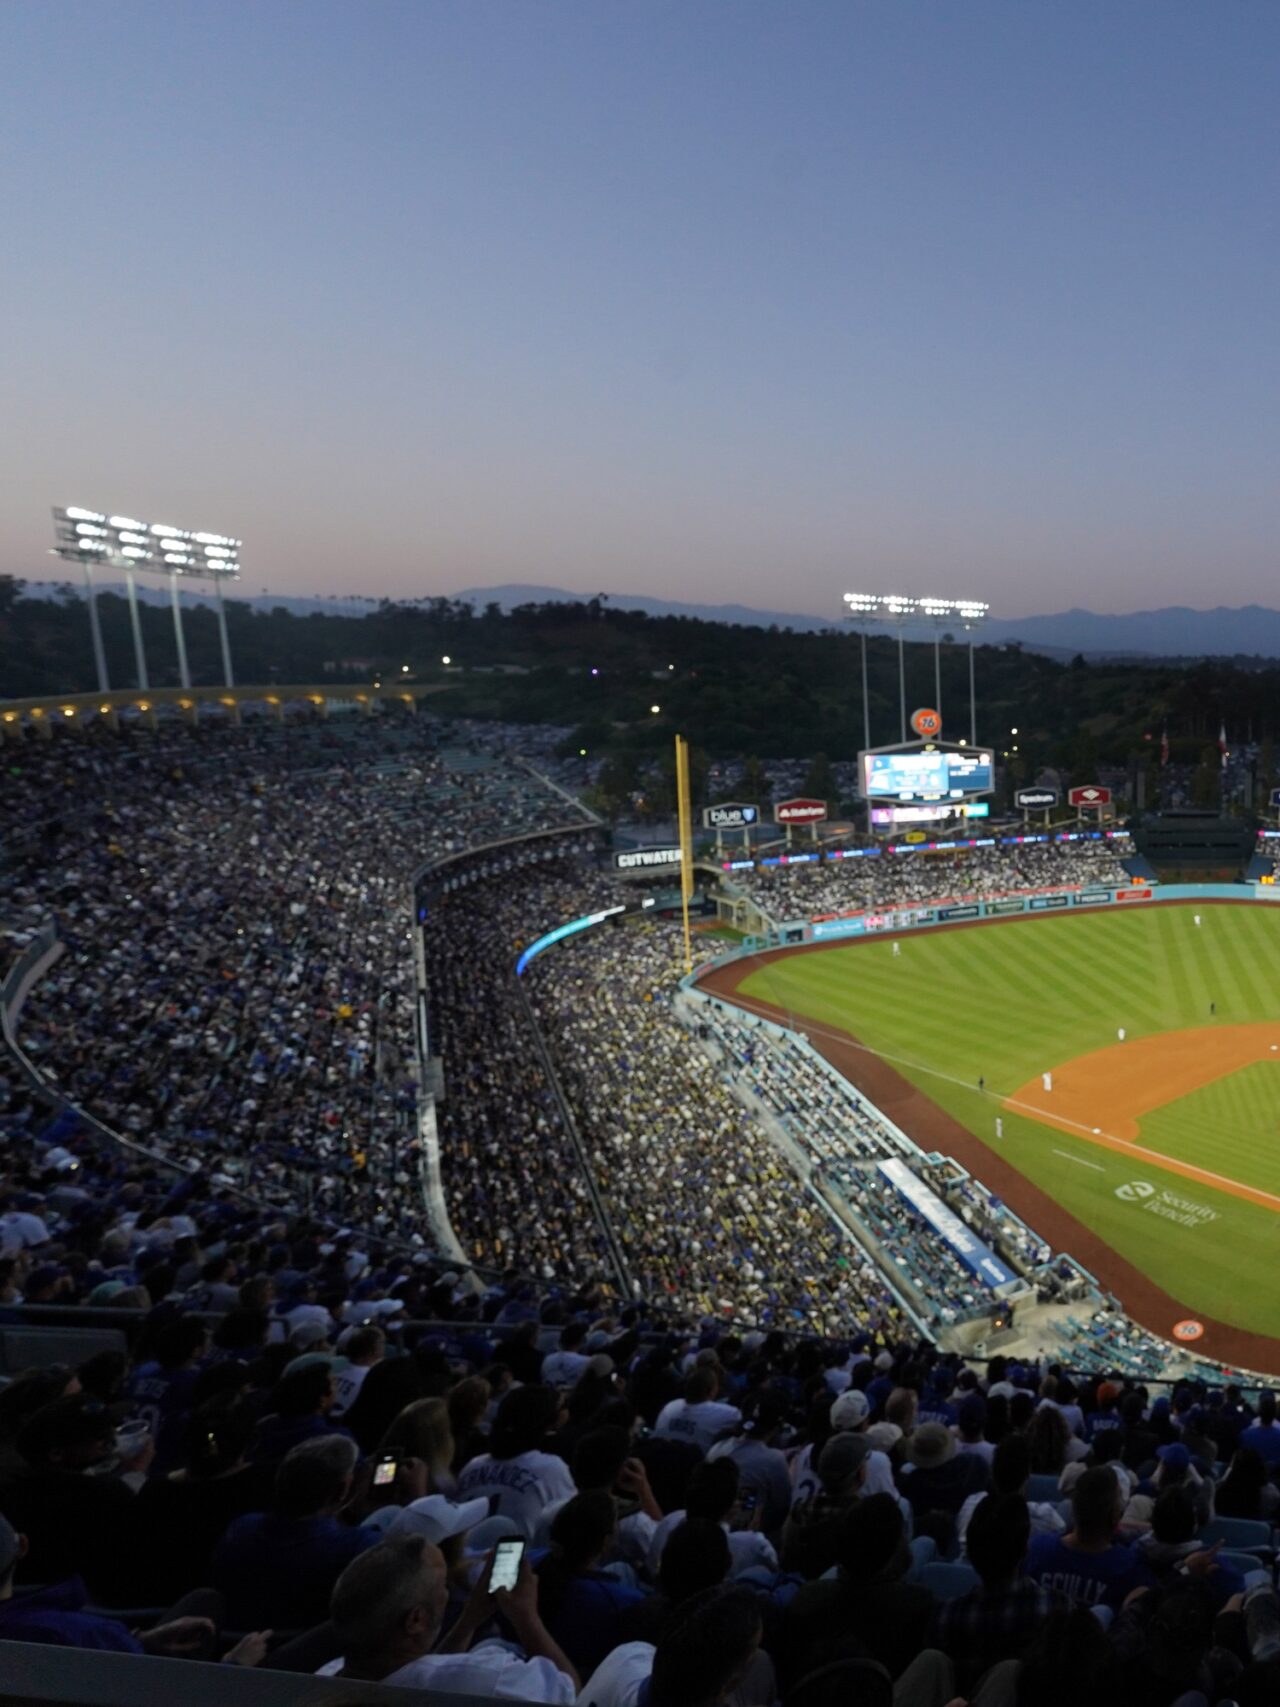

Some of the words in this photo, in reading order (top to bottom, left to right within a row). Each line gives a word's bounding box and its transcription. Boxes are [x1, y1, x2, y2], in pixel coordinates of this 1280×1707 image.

[922, 716, 935, 728] 76
[710, 809, 742, 822] blue
[1143, 1200, 1200, 1228] Benefit
[1157, 1190, 1222, 1221] Security
[1041, 1572, 1107, 1605] SCULLY
